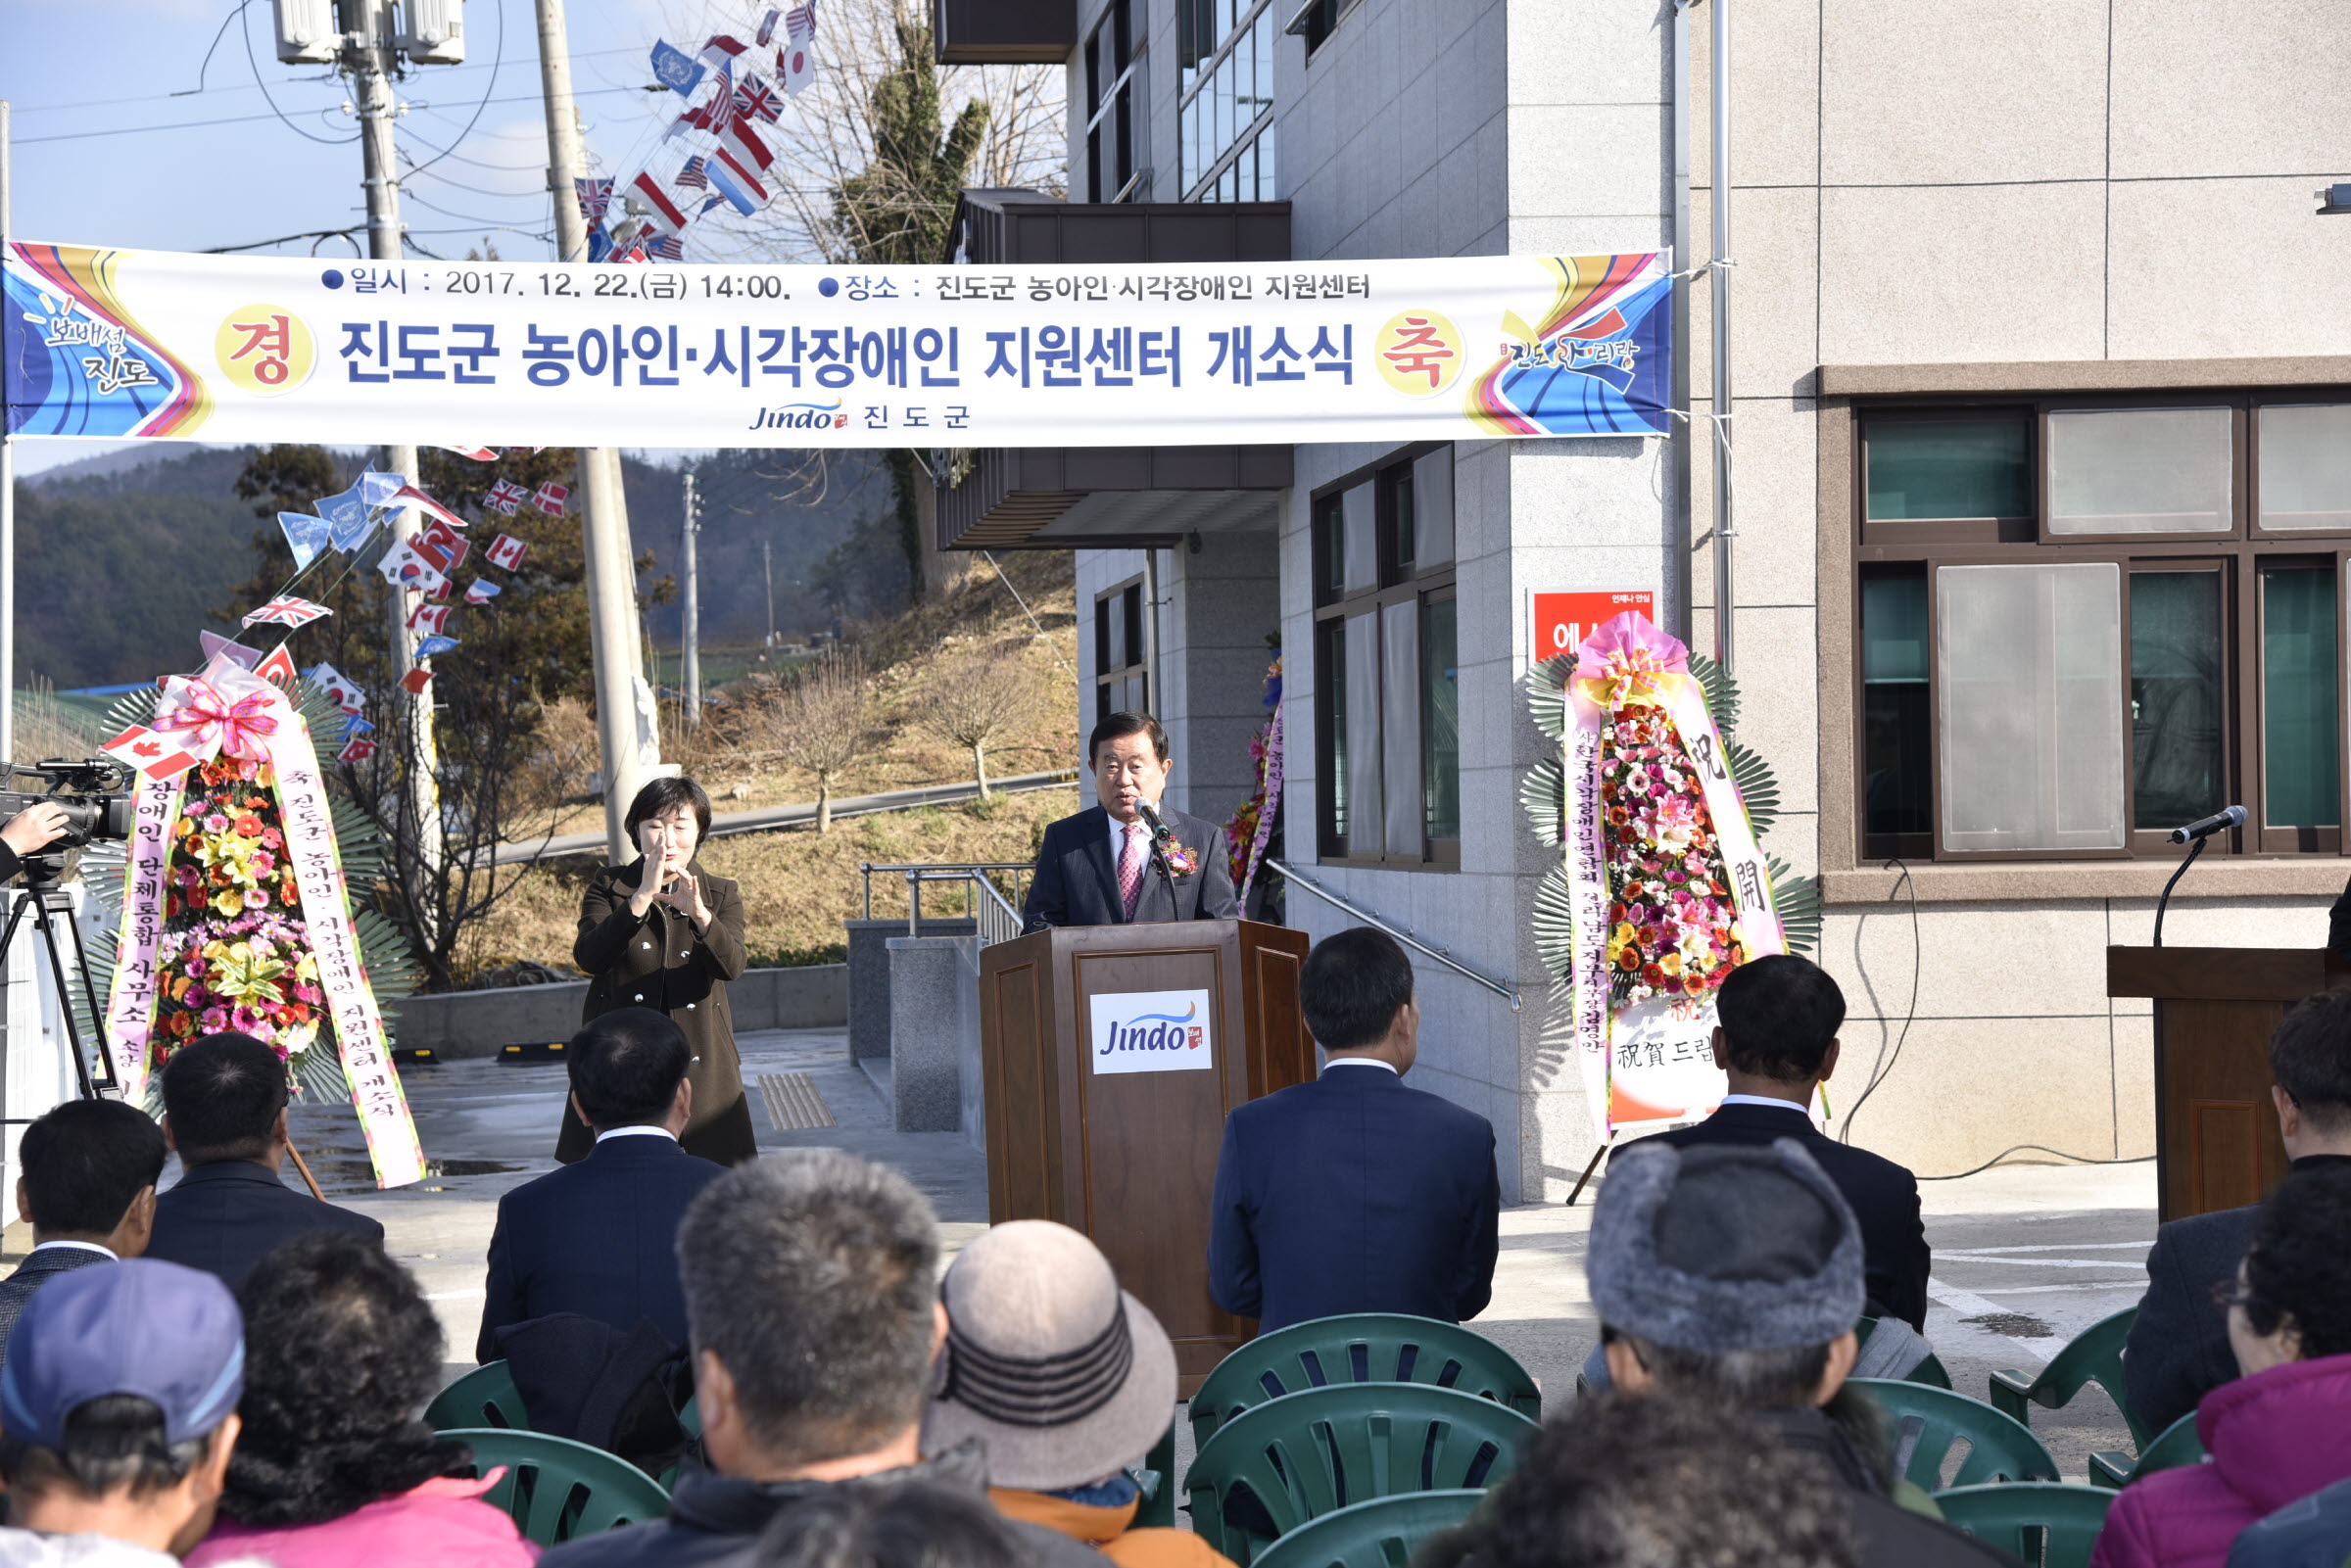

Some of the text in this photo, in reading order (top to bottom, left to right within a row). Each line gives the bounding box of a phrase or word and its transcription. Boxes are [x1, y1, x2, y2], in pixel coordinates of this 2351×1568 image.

[351, 267, 407, 295] 일시
[446, 270, 524, 297] 2017.
[539, 272, 581, 298] 12.
[594, 272, 688, 301] 22.(금)
[700, 274, 791, 301] 14:00.
[844, 274, 899, 302] 장소
[936, 275, 1017, 301] 진도군
[1265, 273, 1369, 300] 지원센터
[47, 318, 125, 355] 보배섬
[230, 313, 290, 386] 경
[339, 319, 501, 385] 진도군
[984, 324, 1181, 389] 지원센터
[1206, 323, 1353, 387] 개소식
[1382, 316, 1455, 388] 축
[84, 356, 157, 393] 진도
[748, 406, 832, 430] Jindo
[1611, 593, 1651, 604] 언제나 안심
[282, 770, 313, 784] 축
[138, 781, 178, 843] 장애인
[288, 793, 327, 841] 진도군
[132, 856, 165, 947] 단체통합
[116, 959, 156, 1023] 사무소
[116, 1038, 139, 1069] 소장
[339, 1004, 378, 1067] 지원센터
[1099, 1021, 1185, 1056] Jindo
[360, 1074, 396, 1117] 개소식
